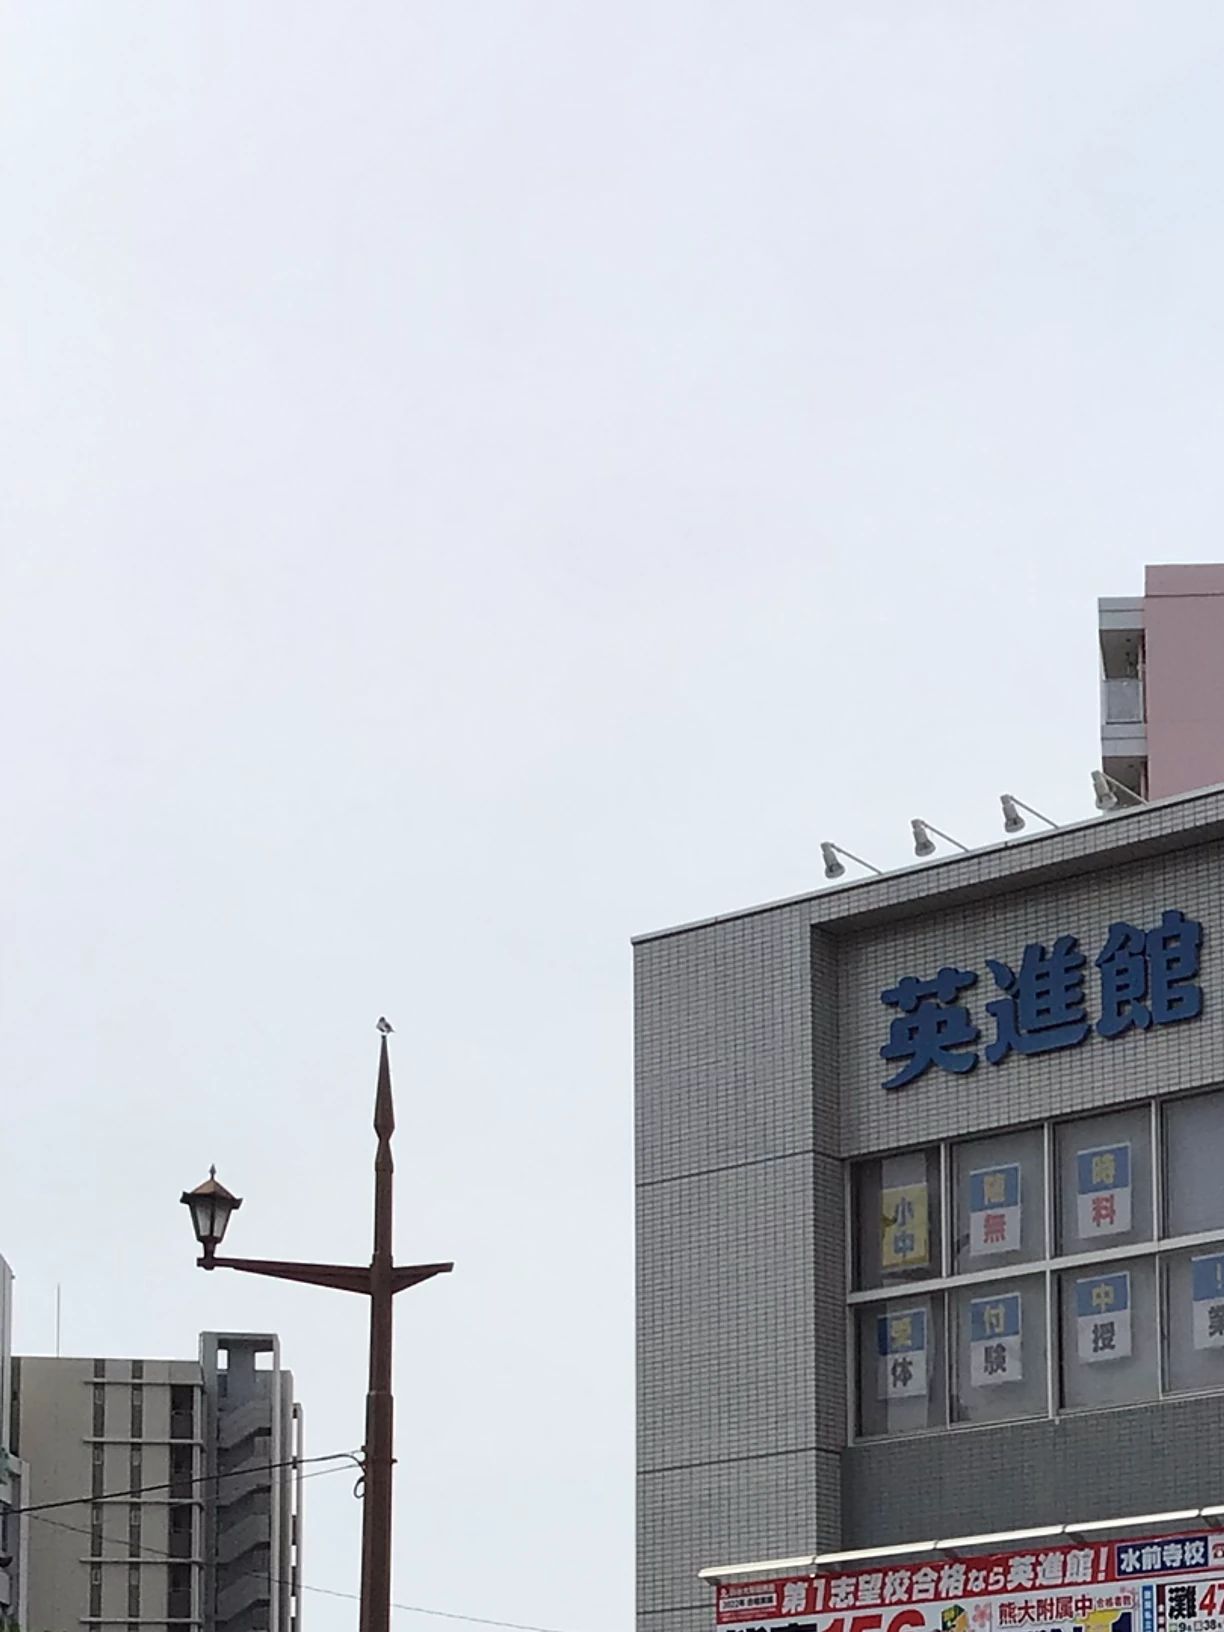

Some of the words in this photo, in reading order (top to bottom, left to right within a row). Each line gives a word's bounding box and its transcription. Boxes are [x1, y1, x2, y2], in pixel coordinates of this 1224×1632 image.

[880, 909, 1204, 1091] 英進館
[1120, 1541, 1205, 1573] 水前寺校
